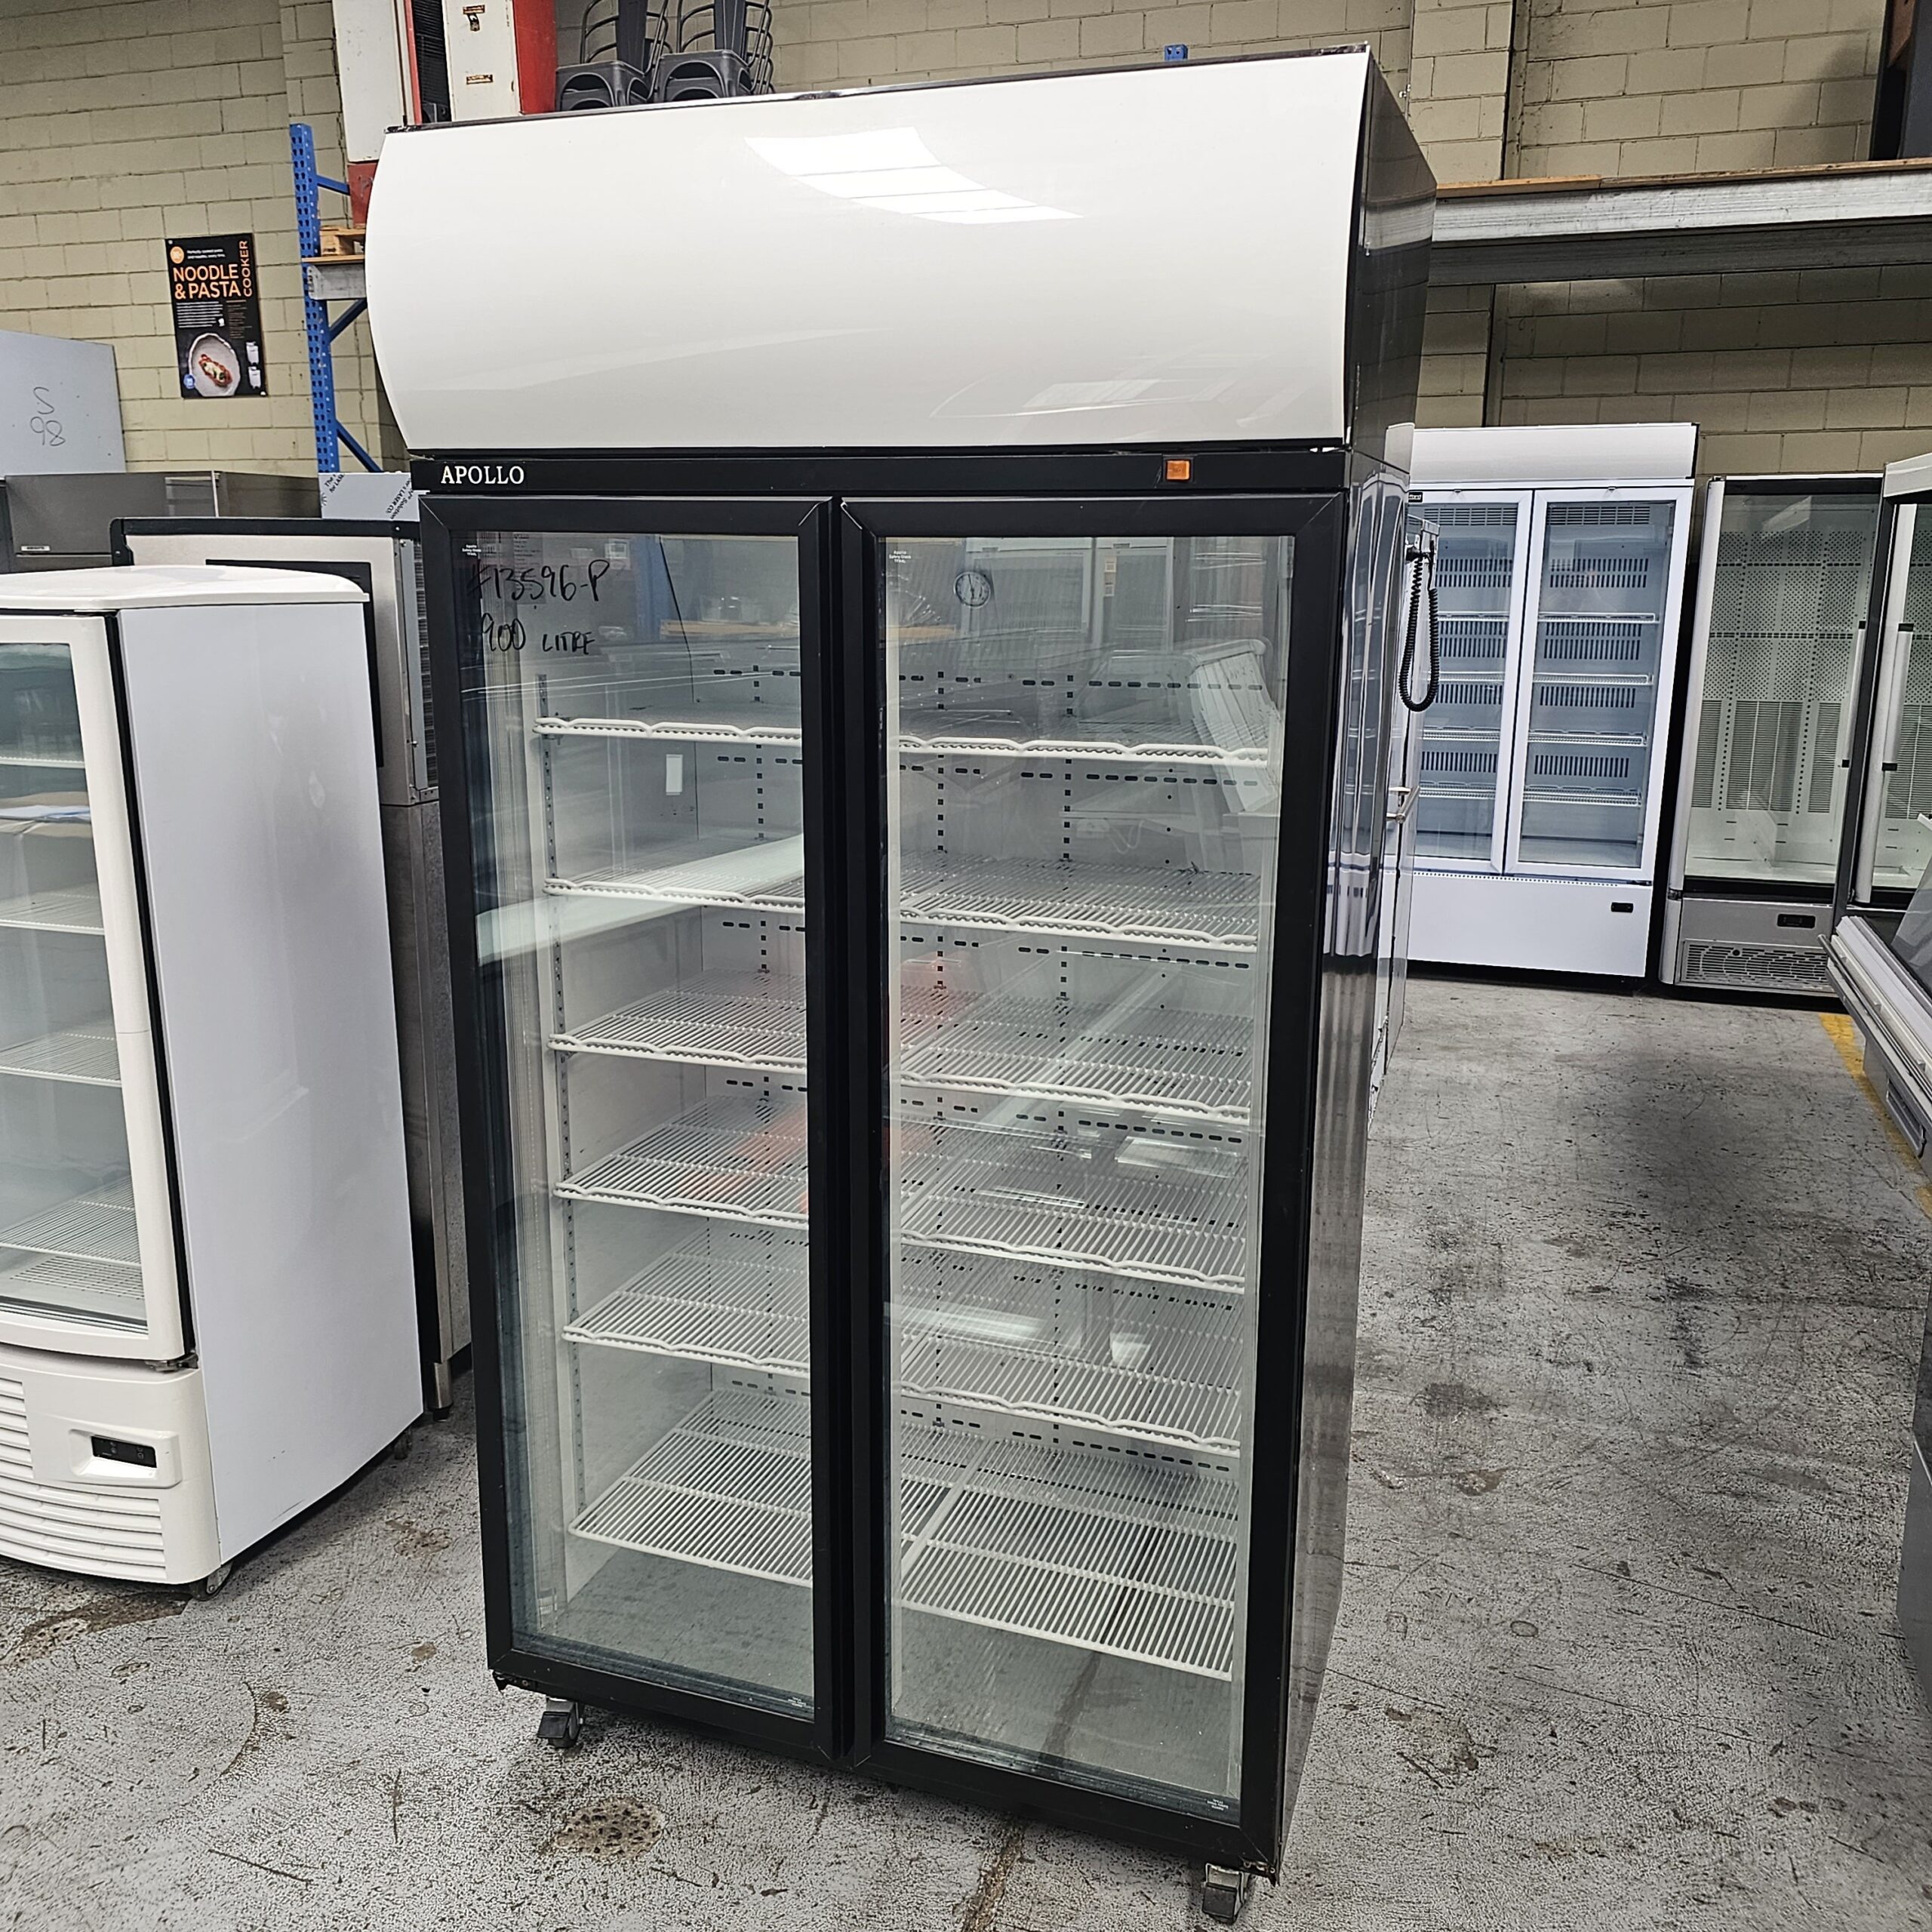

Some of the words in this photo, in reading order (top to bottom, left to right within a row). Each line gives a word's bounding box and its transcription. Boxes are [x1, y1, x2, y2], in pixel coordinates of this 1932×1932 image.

[172, 263, 239, 282] NOODLE
[238, 240, 253, 297] COOKER
[174, 283, 186, 300] &
[188, 280, 242, 300] PASTA
[29, 416, 66, 447] 98
[440, 465, 525, 485] APOLLO
[481, 612, 526, 652] 900
